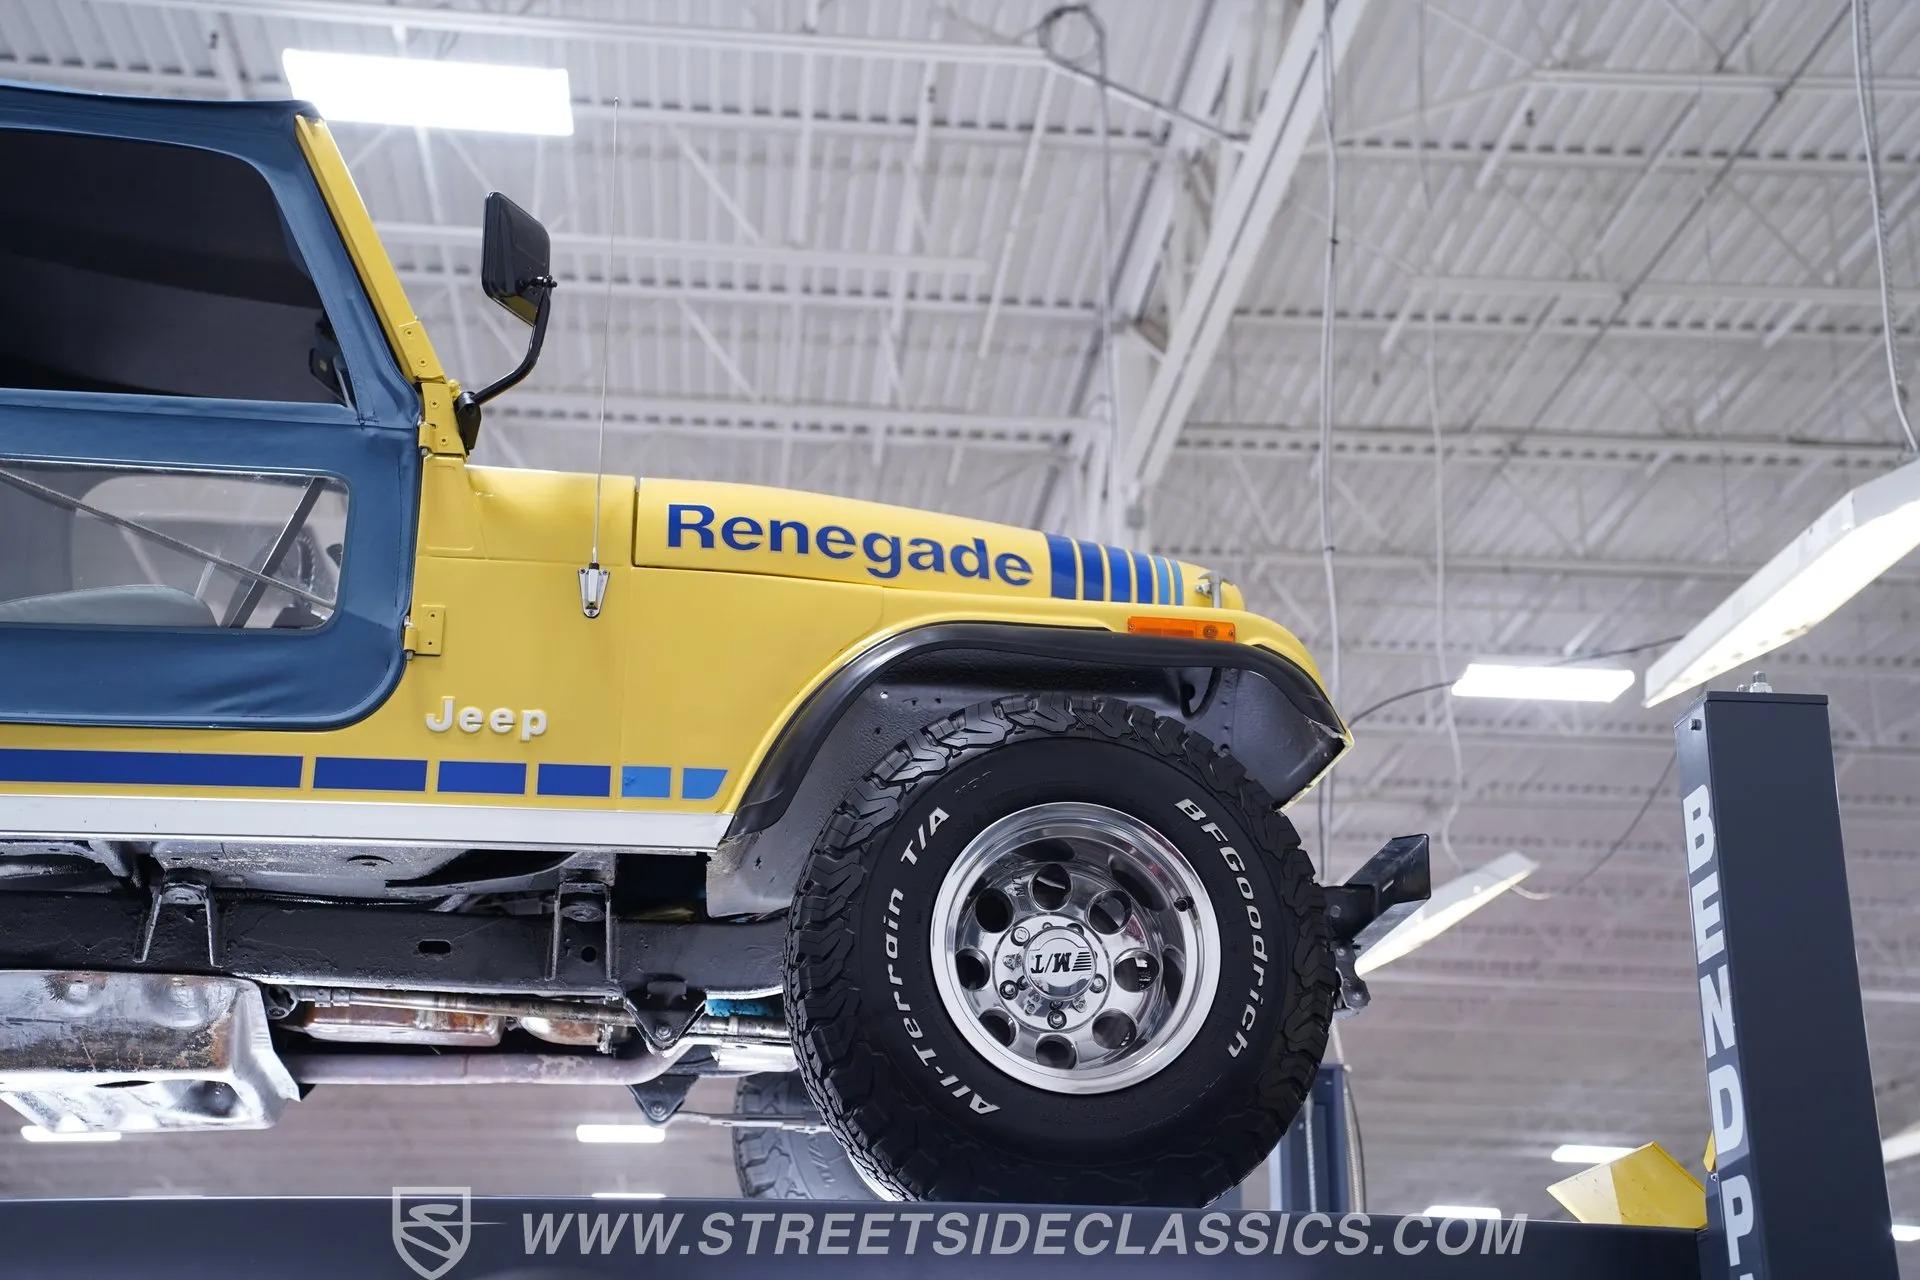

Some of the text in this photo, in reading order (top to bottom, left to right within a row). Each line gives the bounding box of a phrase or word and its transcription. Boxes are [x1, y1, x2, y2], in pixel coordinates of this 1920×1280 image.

[667, 504, 1033, 586] Renegade
[425, 696, 547, 742] Jeep
[882, 806, 1000, 1115] All-Terrain T/A
[1030, 952, 1072, 974] M/T
[1175, 798, 1269, 1059] BFGoodrich
[1683, 784, 1755, 1280] BENDP
